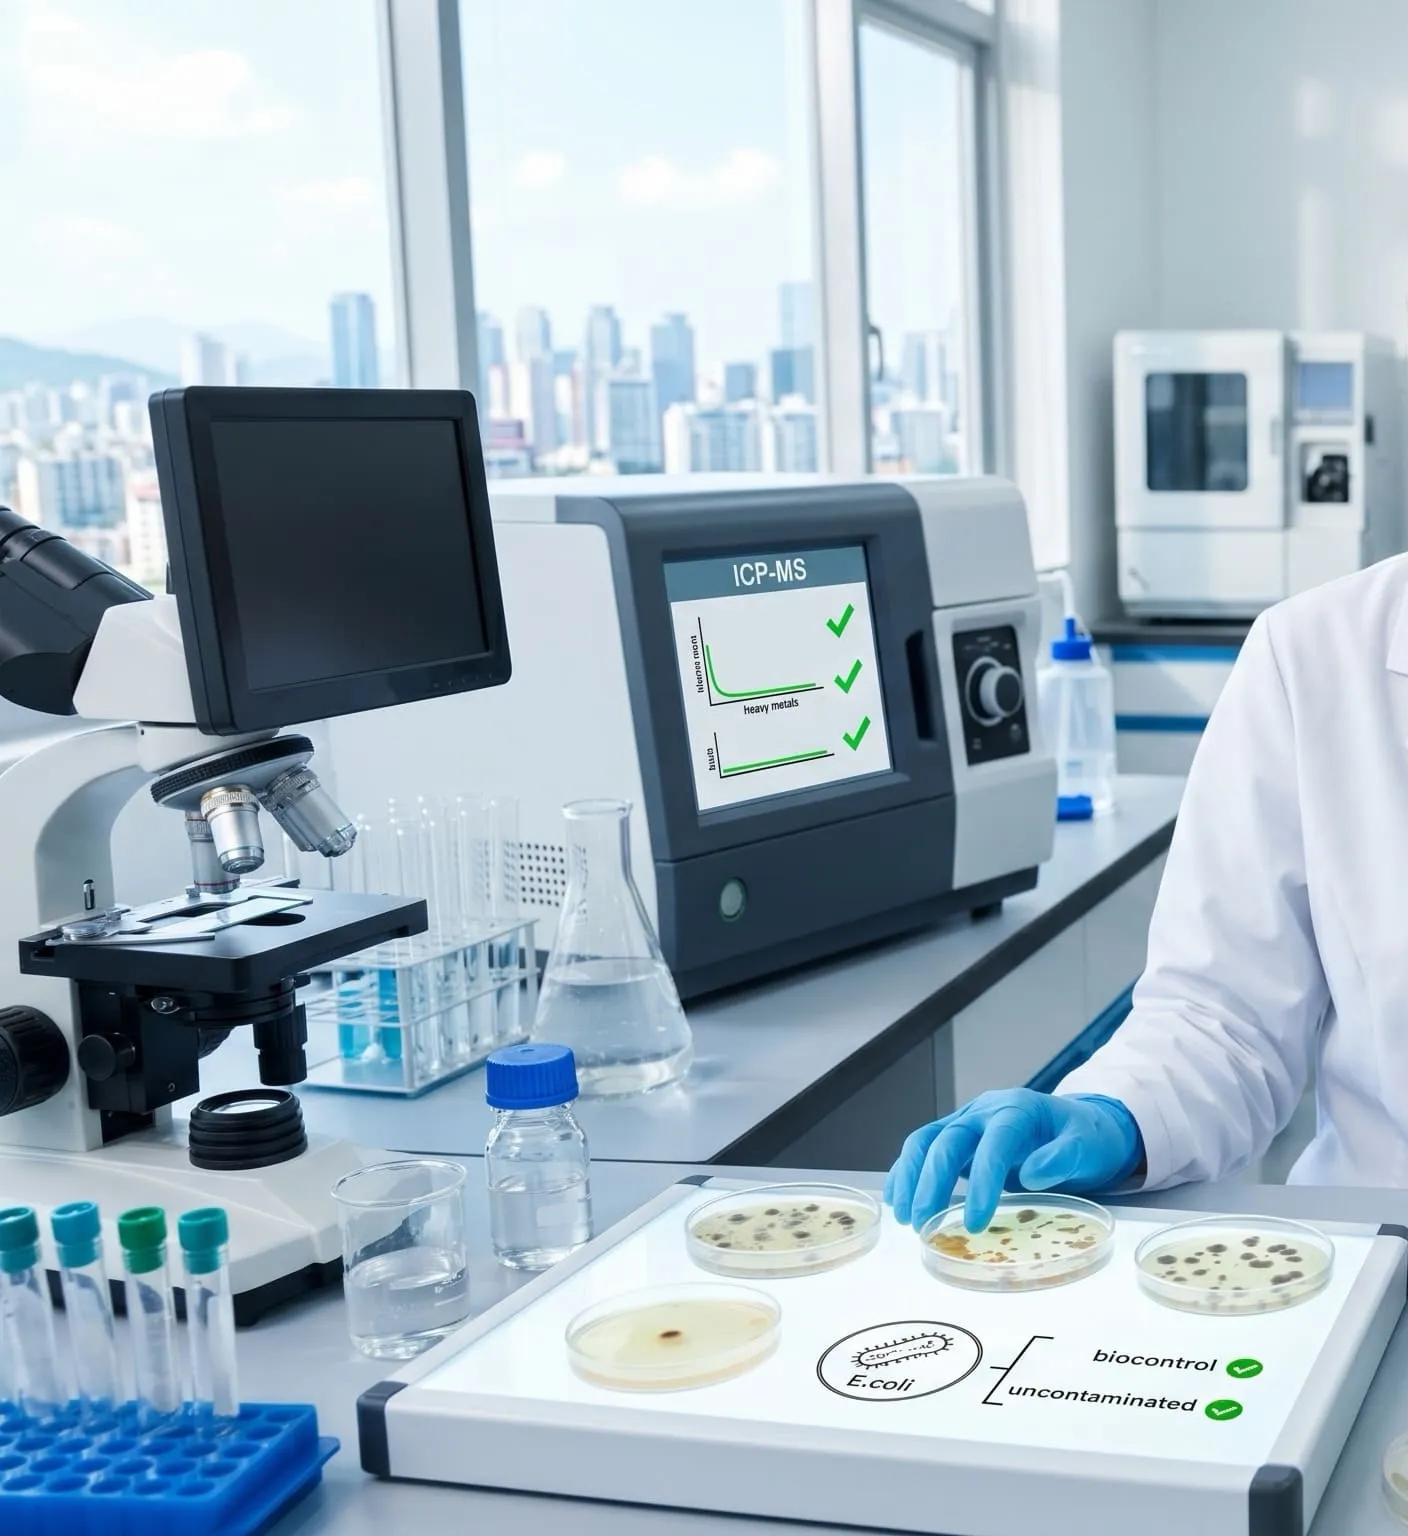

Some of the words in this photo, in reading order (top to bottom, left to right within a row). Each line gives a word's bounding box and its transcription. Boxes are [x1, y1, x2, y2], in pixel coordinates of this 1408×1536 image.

[733, 558, 808, 588] ICP-MS
[743, 703, 770, 716] Heavy
[770, 696, 800, 712] metals
[1092, 1348, 1218, 1373] biocontrol
[845, 1373, 916, 1392] E.coli
[1008, 1385, 1199, 1412] uncontaminated
